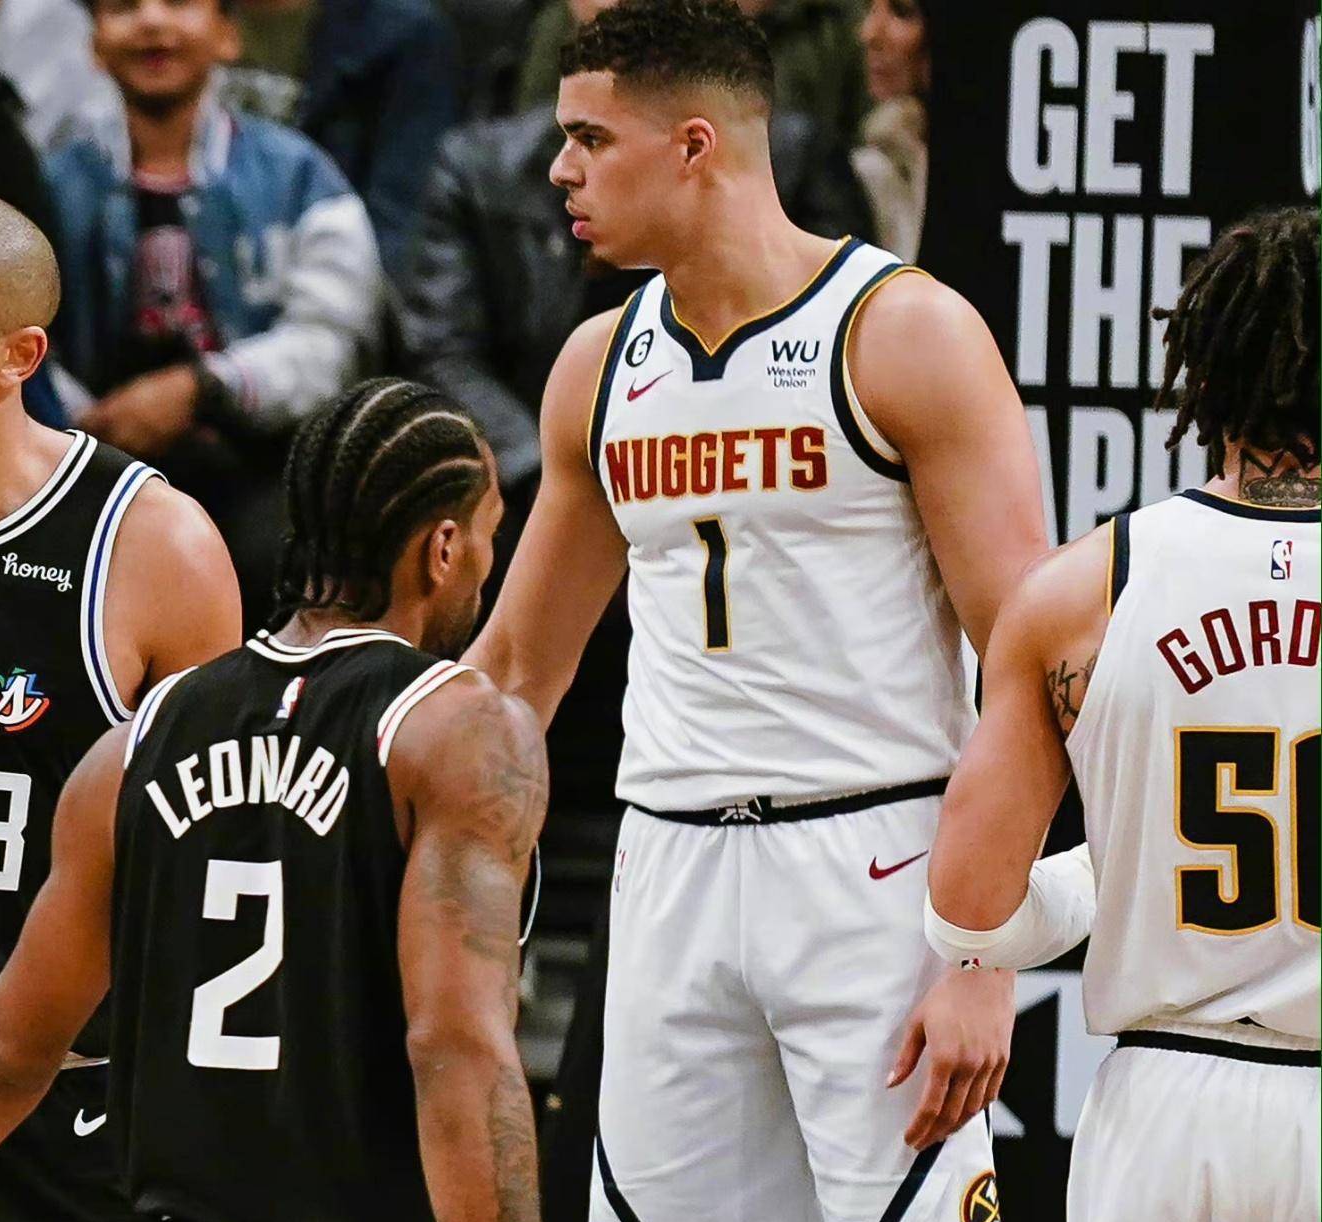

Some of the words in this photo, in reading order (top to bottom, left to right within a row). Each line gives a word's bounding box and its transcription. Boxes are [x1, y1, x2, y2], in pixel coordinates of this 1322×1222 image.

[1008, 17, 1215, 196] GET
[1002, 211, 1211, 388] THE
[767, 366, 816, 377] Western
[772, 340, 820, 362] WU
[773, 378, 807, 388] Union
[605, 426, 828, 505] NUGGETS
[2, 552, 72, 592] honey
[690, 514, 733, 653] 1
[145, 735, 350, 839] LEONARD
[187, 858, 284, 1071] 2
